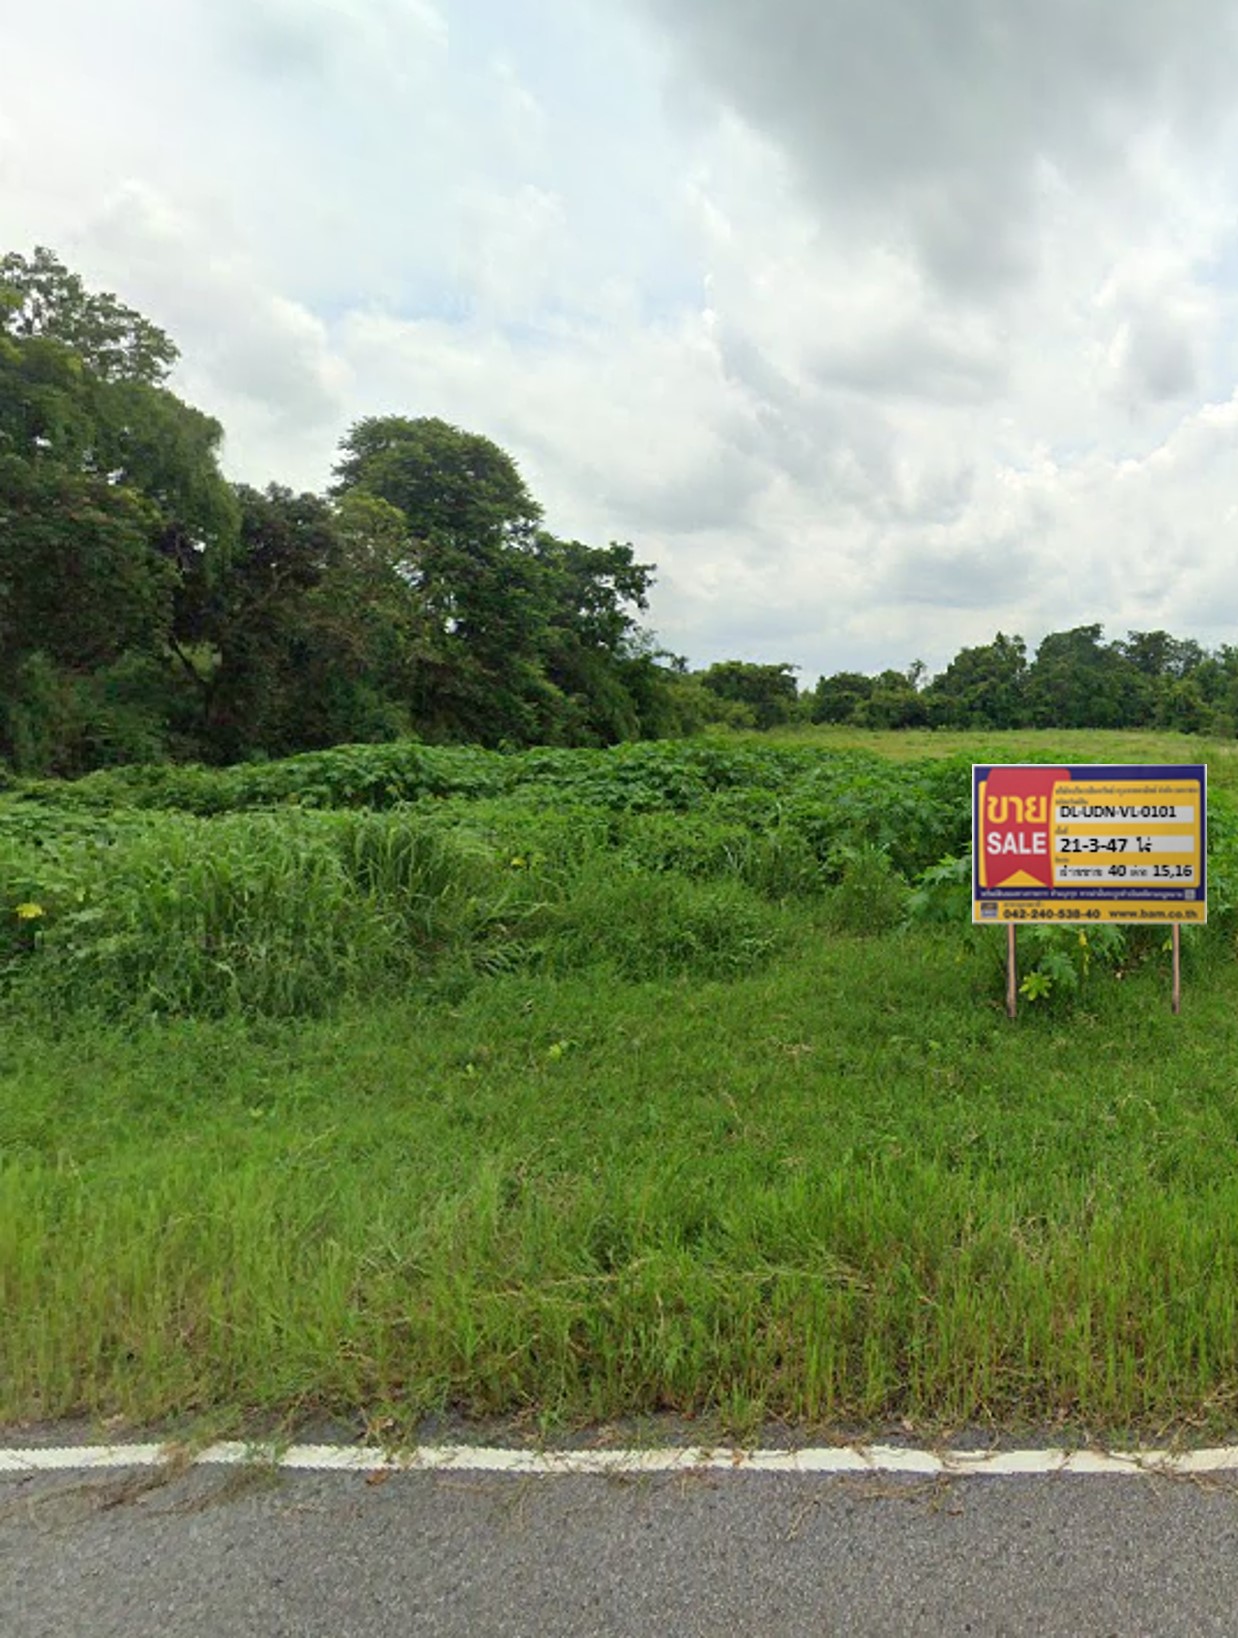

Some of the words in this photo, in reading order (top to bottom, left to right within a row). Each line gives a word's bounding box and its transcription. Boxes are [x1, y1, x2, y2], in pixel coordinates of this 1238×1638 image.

[987, 796, 1047, 824] ขาย
[1060, 805, 1177, 818] DL-UDN-VL-0101
[987, 832, 1047, 855] SALE
[1060, 838, 1128, 853] 21-3-47
[1108, 864, 1127, 877] 40
[1153, 864, 1193, 879] 15,16
[1109, 908, 1199, 919] www.bam.co.th
